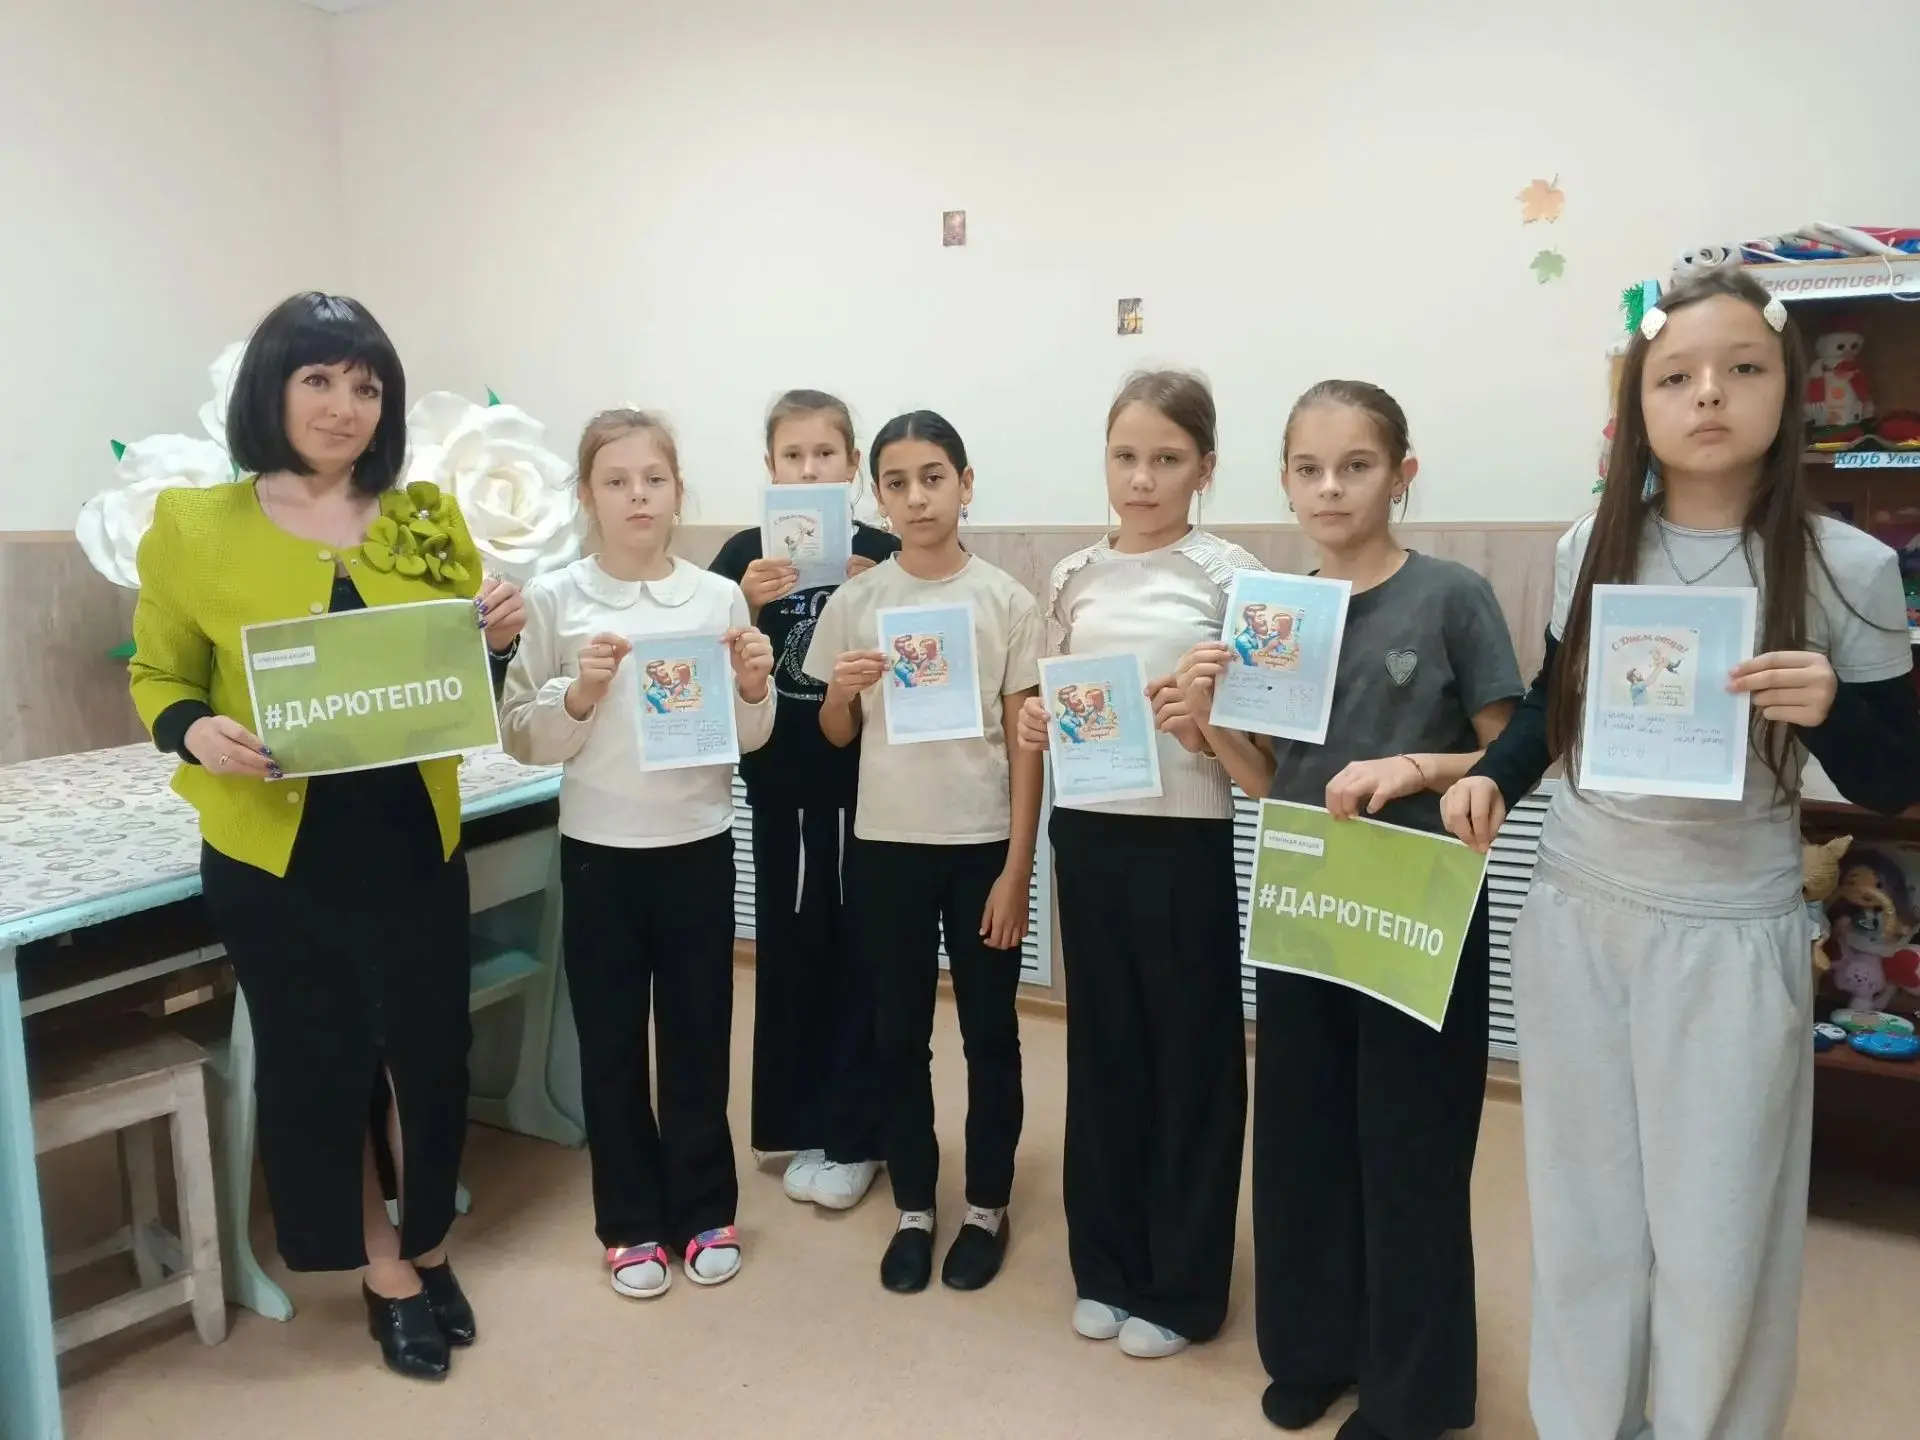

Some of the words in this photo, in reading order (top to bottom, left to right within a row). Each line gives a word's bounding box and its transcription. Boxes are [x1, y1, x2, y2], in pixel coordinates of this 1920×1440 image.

[1836, 452, 1880, 467] Клуб
[264, 675, 464, 731] #ДАРЮТЕПЛО
[1258, 883, 1445, 957] #ДАРЮТЕПЛО
